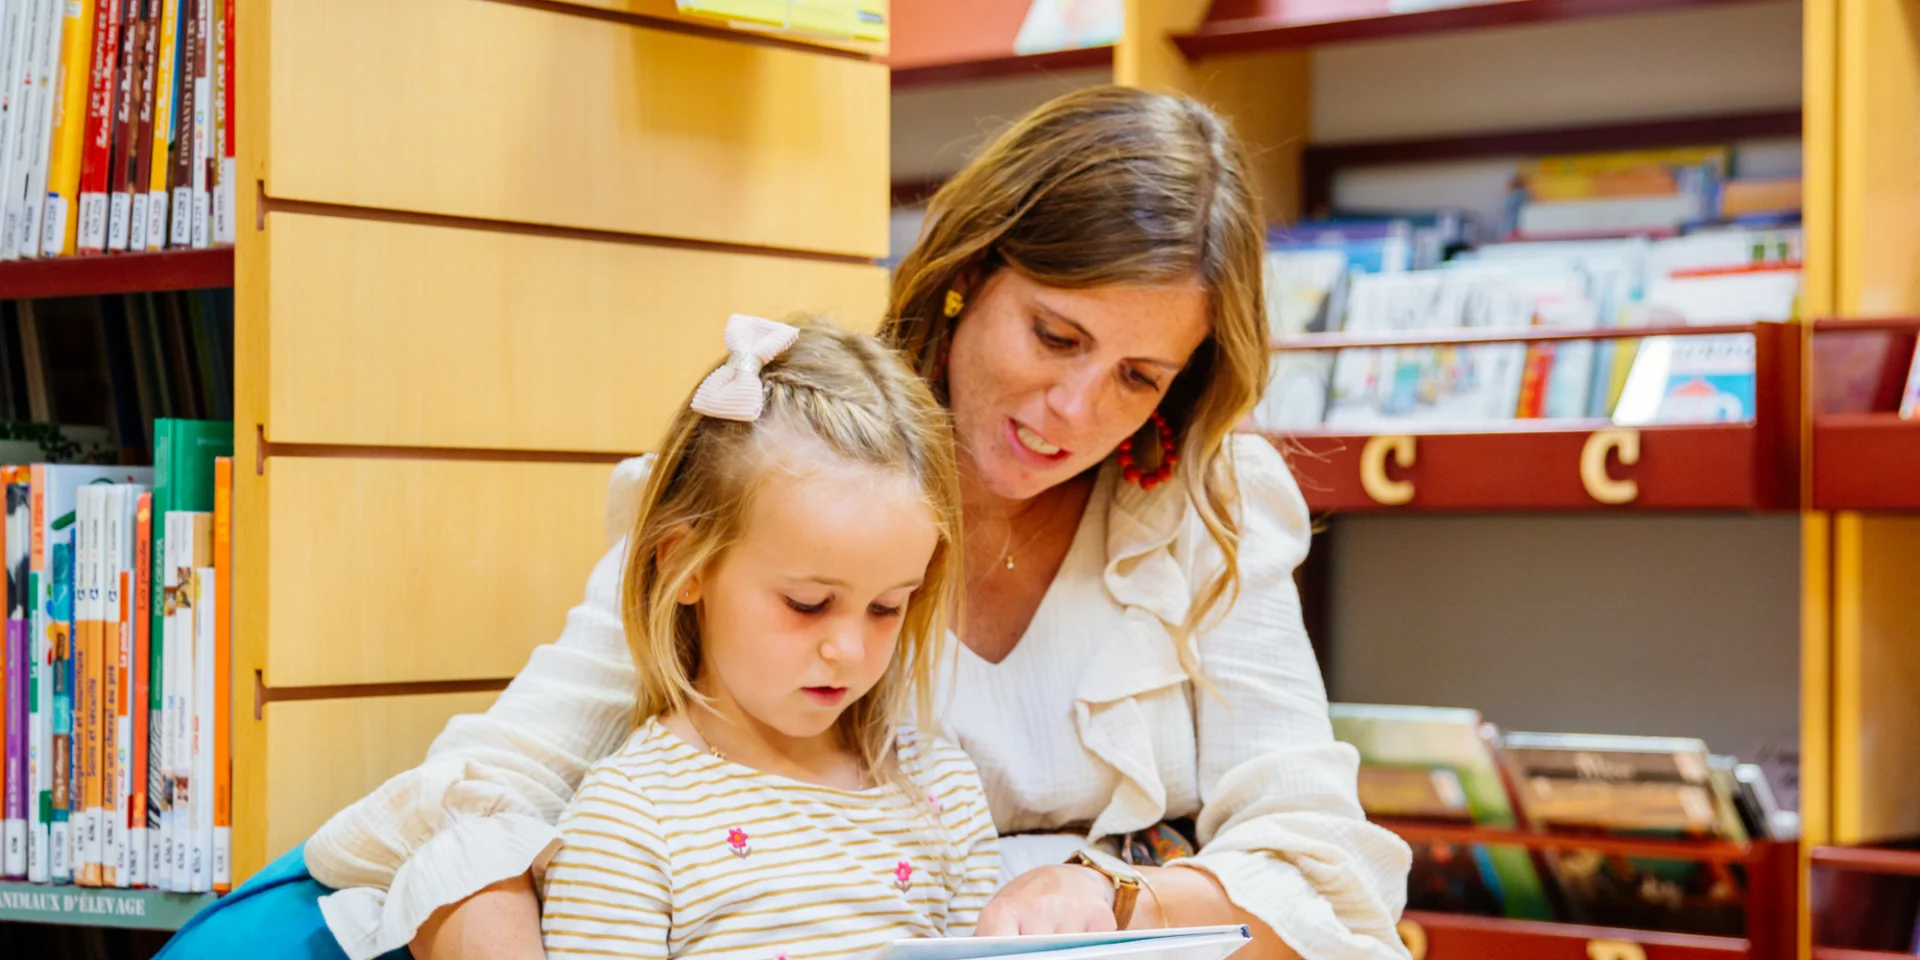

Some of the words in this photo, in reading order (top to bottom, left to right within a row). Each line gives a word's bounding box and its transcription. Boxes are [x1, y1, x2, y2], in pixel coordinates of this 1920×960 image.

[1360, 435, 1417, 505] C
[1580, 428, 1640, 505] C
[104, 709, 115, 749] cheval
[0, 890, 61, 912] NIMAUX
[63, 890, 147, 916] D'ÉLEVAGE
